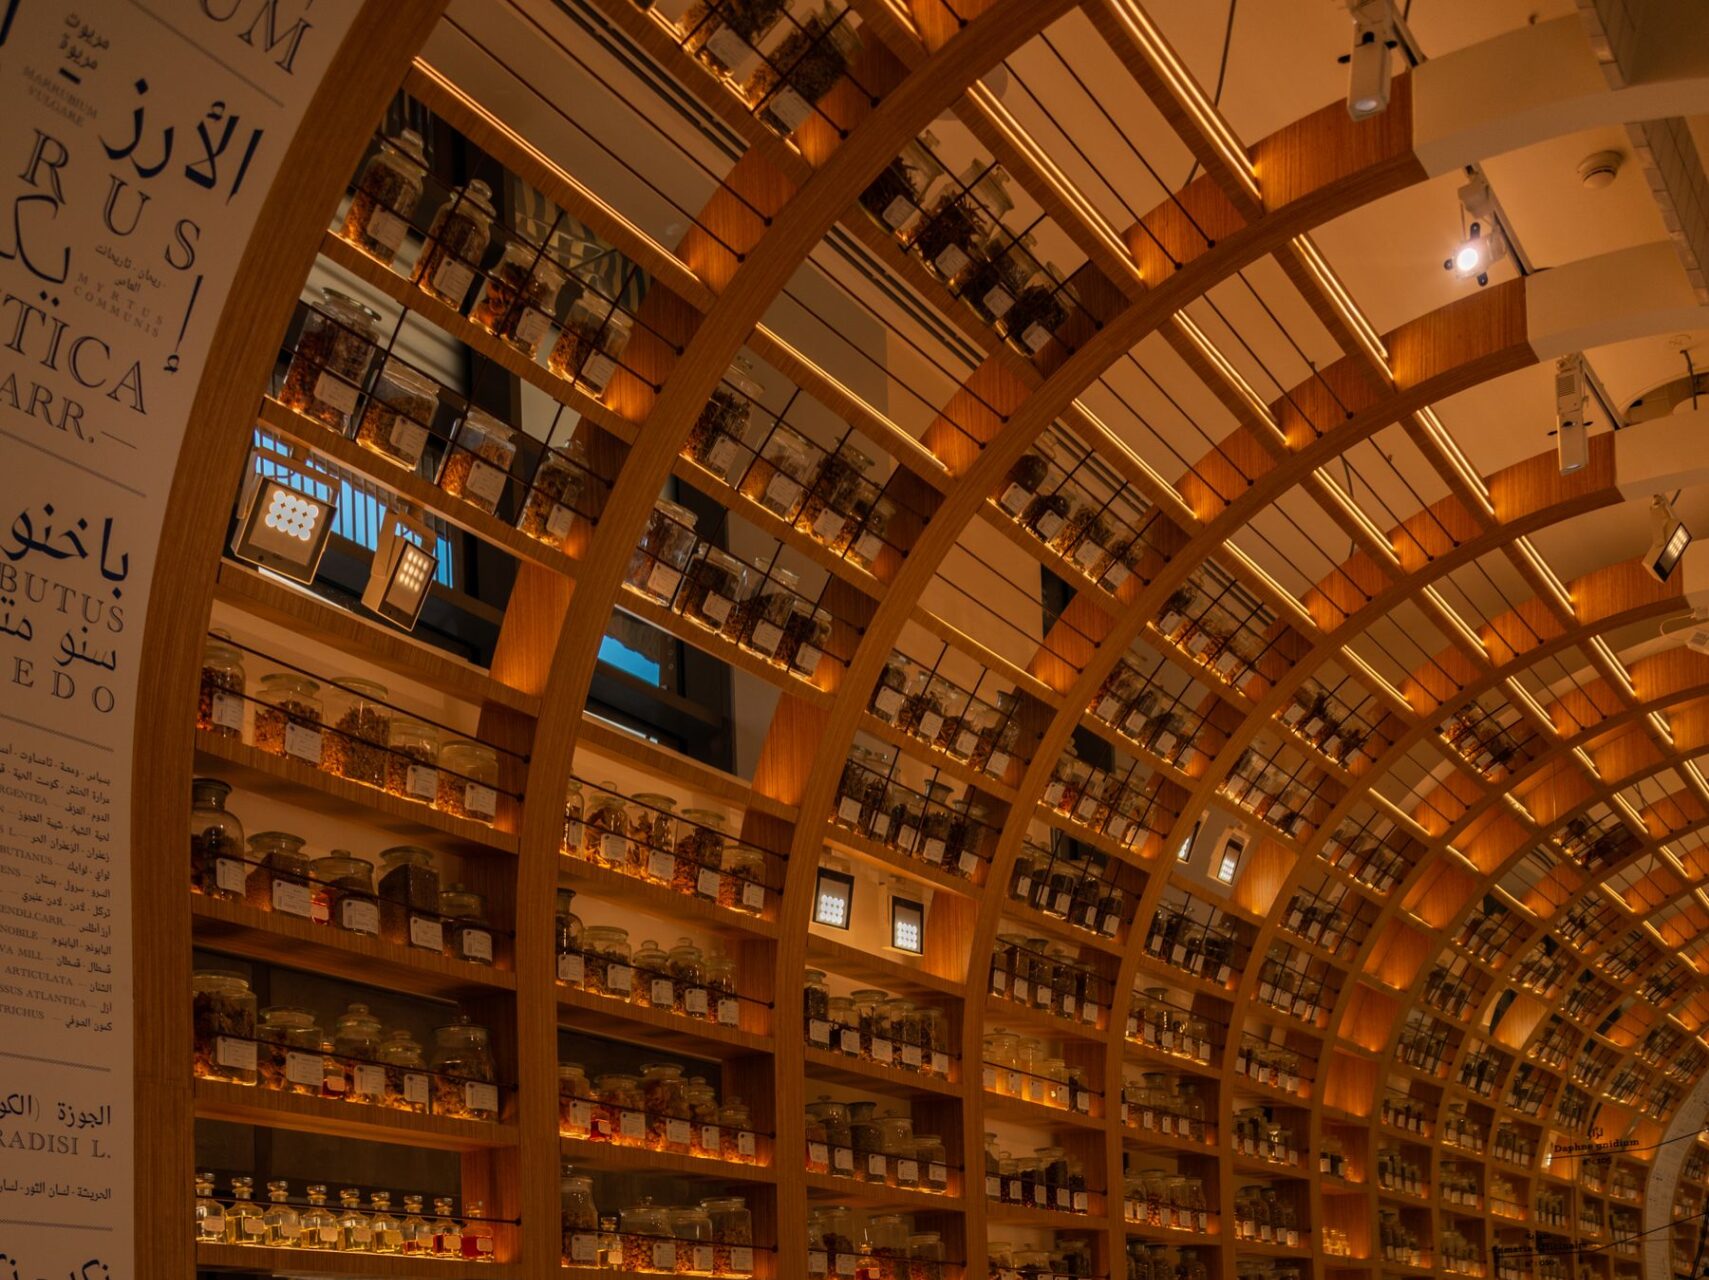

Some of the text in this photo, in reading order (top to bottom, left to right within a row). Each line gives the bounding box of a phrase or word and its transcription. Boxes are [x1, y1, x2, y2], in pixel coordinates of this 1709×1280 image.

[73, 285, 159, 338] COMMUNIS
[4, 966, 73, 986] ARTICULATA
[26, 989, 87, 1008] ATLANTICA
